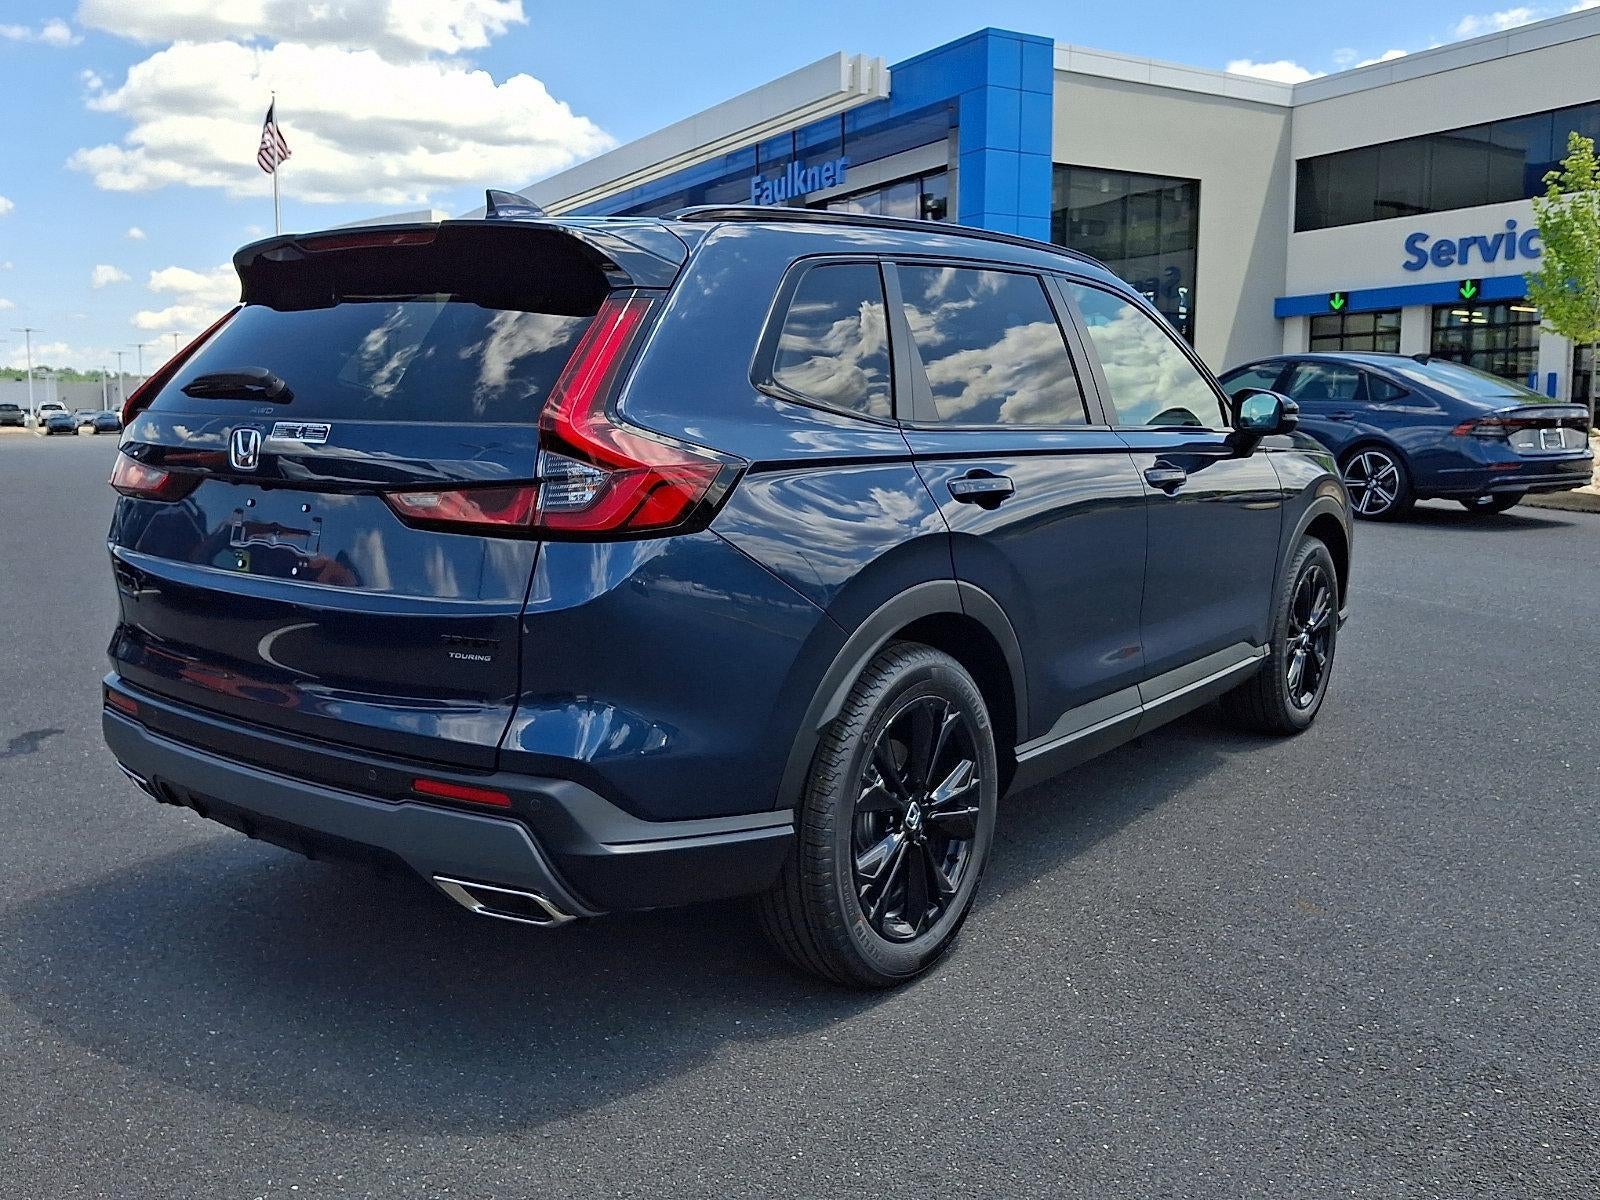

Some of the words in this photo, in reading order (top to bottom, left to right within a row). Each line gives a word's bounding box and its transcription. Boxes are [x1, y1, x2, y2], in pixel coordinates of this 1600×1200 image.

[751, 156, 849, 206] Faulkner
[1402, 219, 1542, 271] Servic
[448, 651, 492, 662] TOURING
